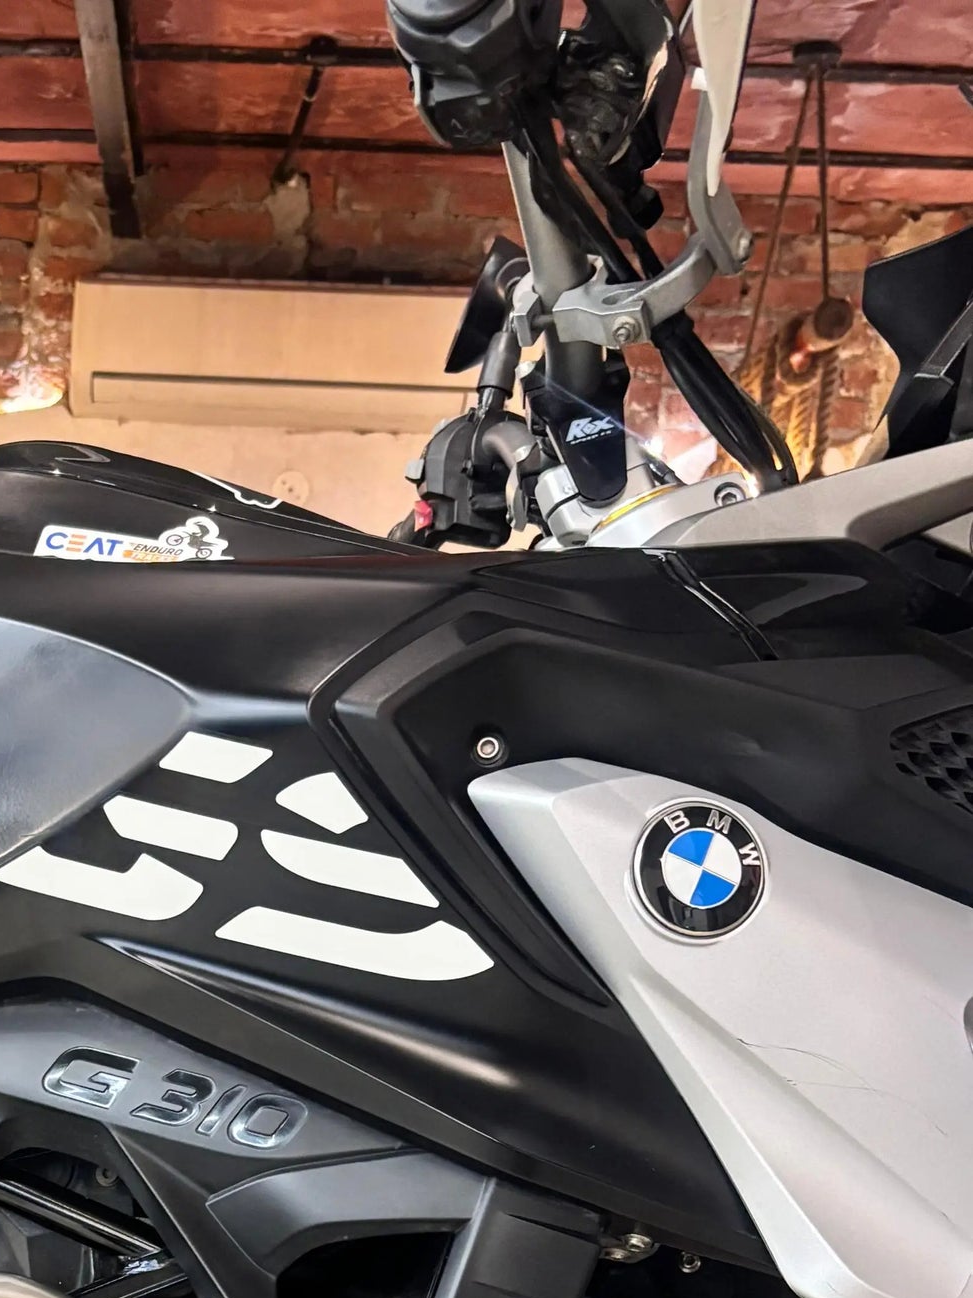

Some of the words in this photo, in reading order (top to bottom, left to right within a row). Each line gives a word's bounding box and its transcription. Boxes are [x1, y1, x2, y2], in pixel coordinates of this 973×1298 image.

[46, 531, 123, 557] CEAT
[133, 543, 183, 556] ENDURO
[664, 809, 761, 866] BMW
[42, 1046, 140, 1109] G
[129, 1068, 308, 1149] 310
